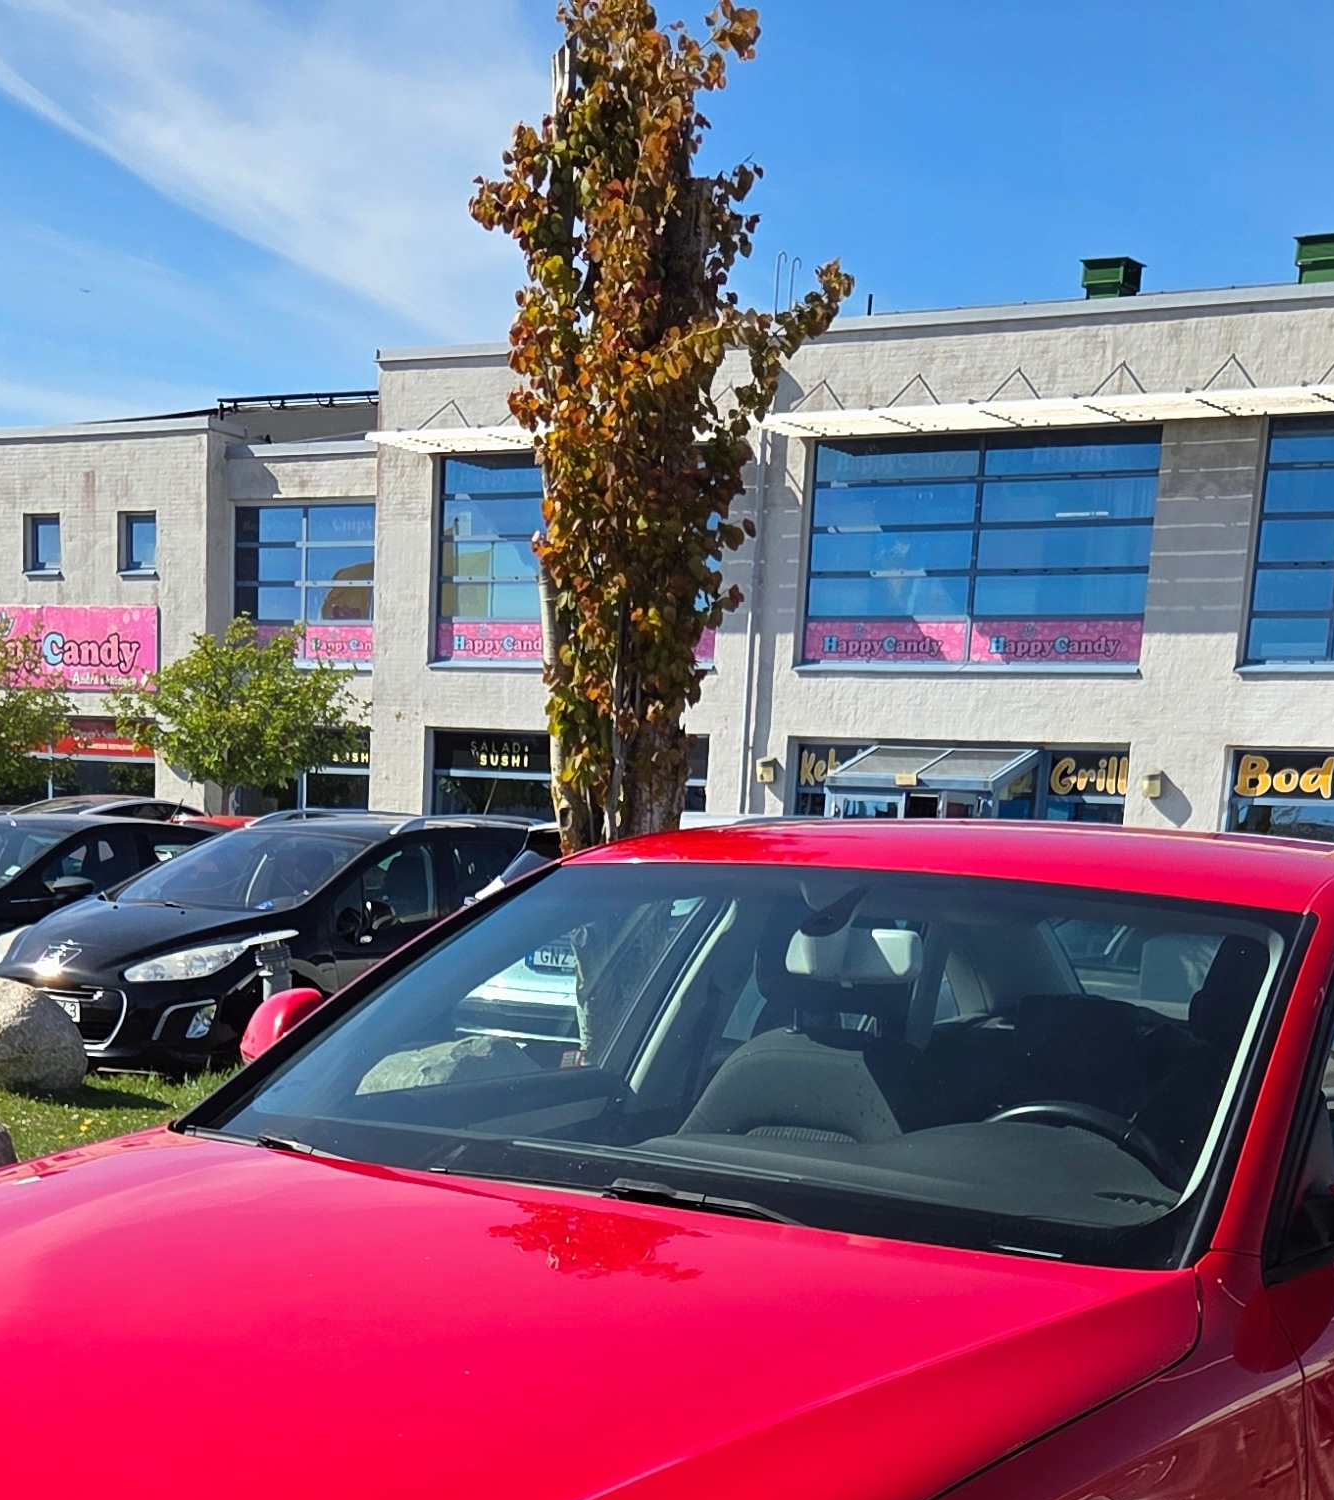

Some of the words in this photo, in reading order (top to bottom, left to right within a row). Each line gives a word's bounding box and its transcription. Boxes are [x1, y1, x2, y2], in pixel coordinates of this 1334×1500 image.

[310, 638, 372, 654] HappyCan
[453, 635, 542, 654] HappyCand
[823, 635, 943, 657] HappyCandy
[989, 635, 1121, 657] HappyCandy
[470, 740, 521, 753] SALAD
[479, 752, 529, 768] SUSHI
[1050, 755, 1128, 795] Grill
[540, 947, 570, 966] GNZ
